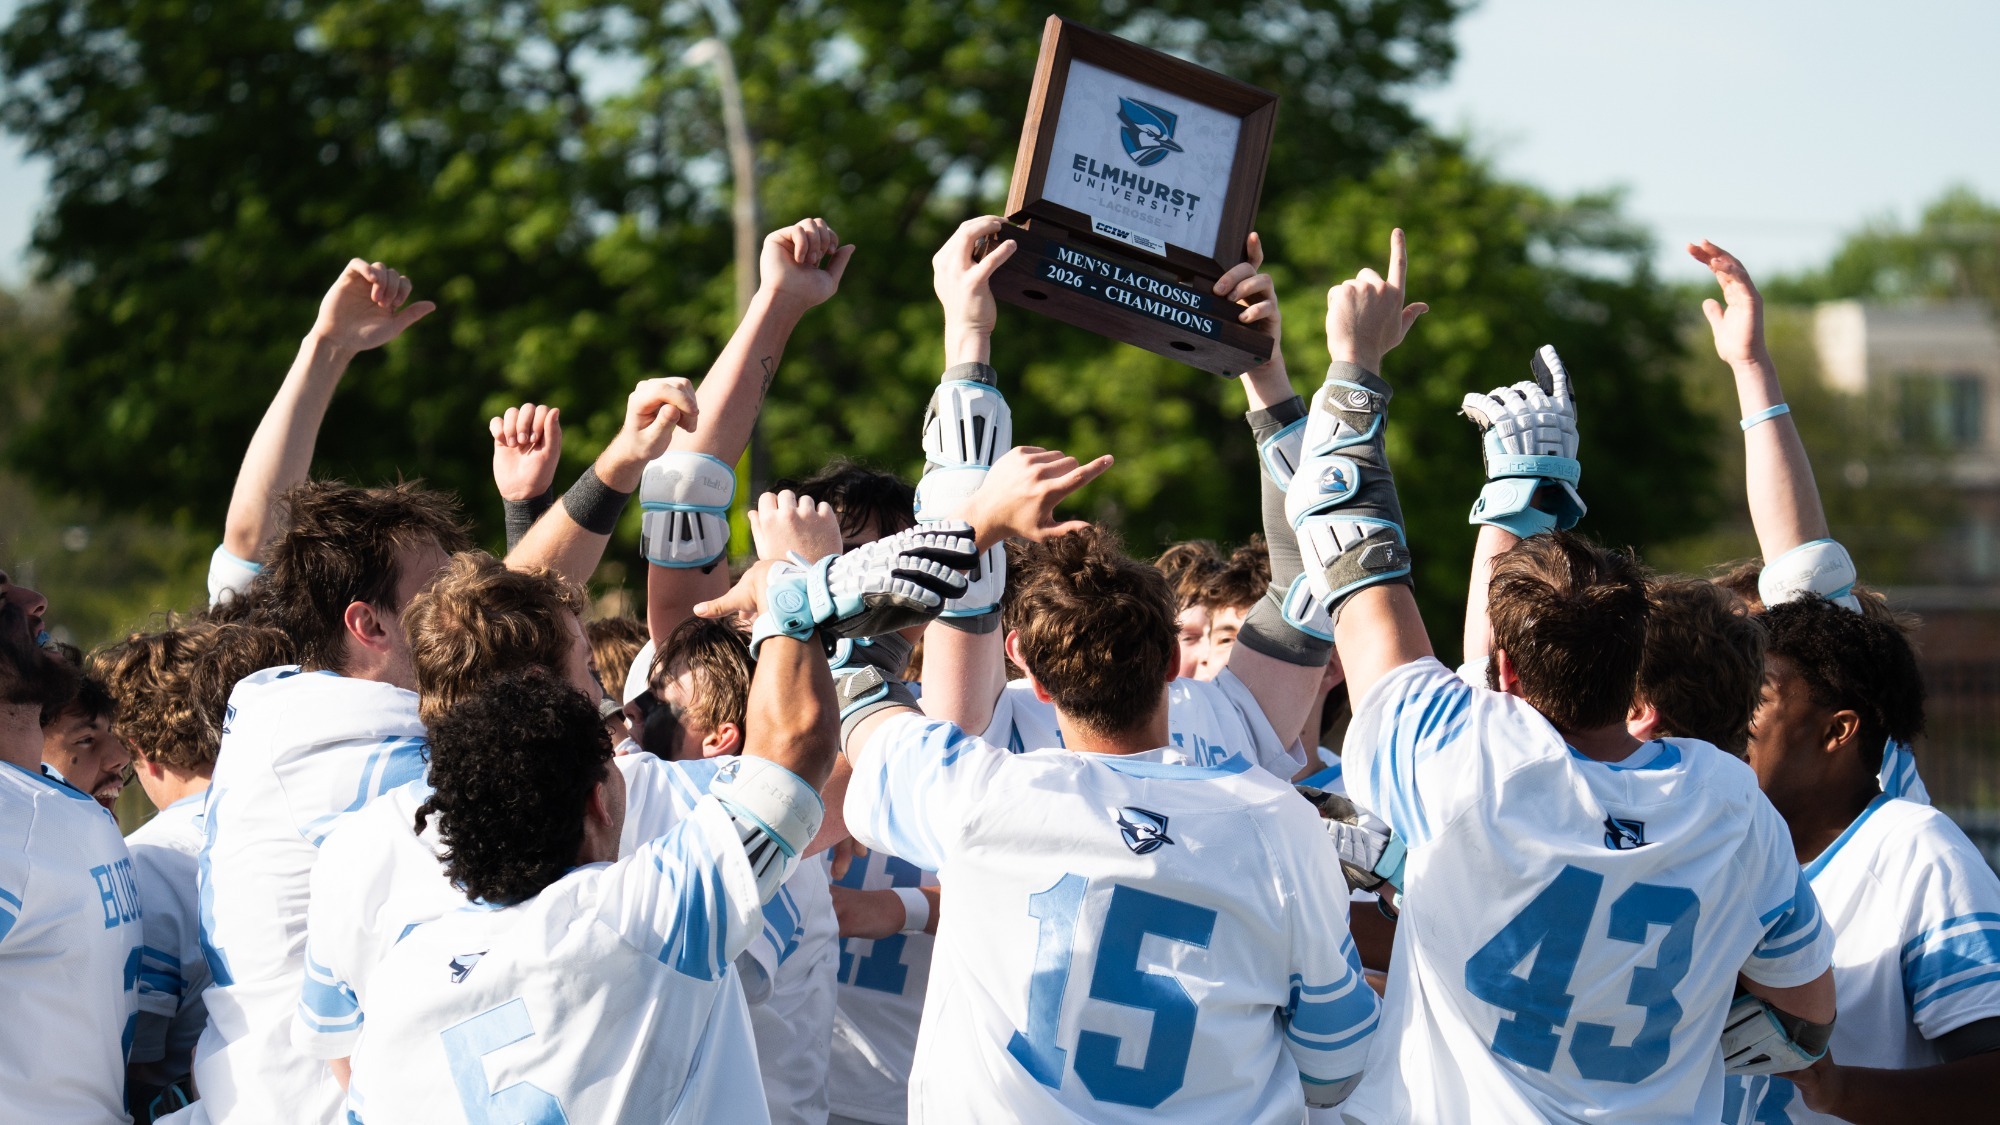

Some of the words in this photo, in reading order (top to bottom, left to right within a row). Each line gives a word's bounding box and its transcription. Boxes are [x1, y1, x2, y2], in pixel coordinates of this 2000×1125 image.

[1072, 153, 1200, 211] ELMHURST
[1073, 173, 1194, 222] UNIVERSITY
[1095, 222, 1130, 240] CCIW
[1098, 200, 1162, 228] LACROSSE
[1046, 265, 1084, 288] 2026
[1105, 286, 1213, 333] CHAMPIONS
[1057, 247, 1111, 277] MEN'S
[1113, 267, 1201, 309] LACROSSE
[1007, 872, 1217, 1109] 15
[1464, 864, 1700, 1084] 43
